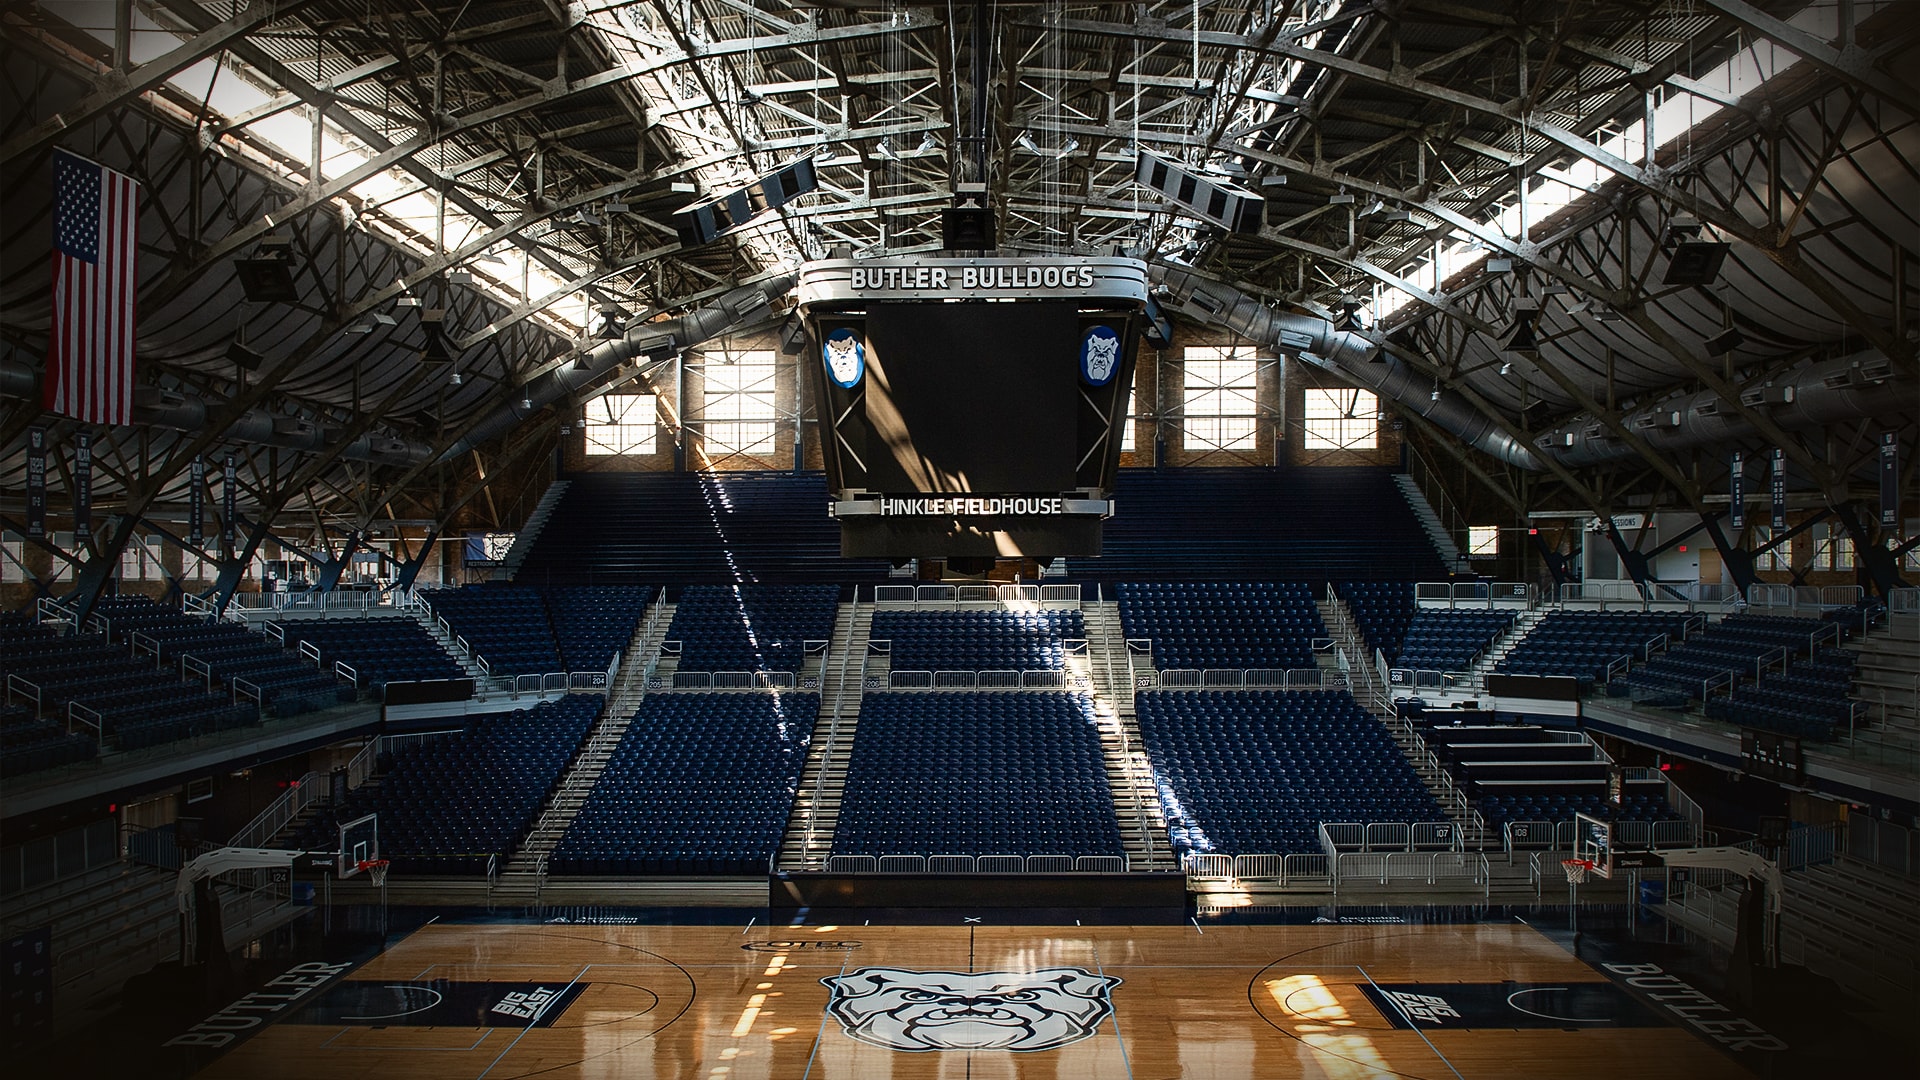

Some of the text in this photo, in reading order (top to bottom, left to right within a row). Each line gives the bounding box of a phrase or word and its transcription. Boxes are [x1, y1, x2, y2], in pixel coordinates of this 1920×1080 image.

[851, 266, 1094, 289] BUTLER BULLDOGS
[880, 498, 1062, 516] HINKLE FIELDHOUSE
[1614, 518, 1636, 528] ESSIONS
[1513, 588, 1526, 596] 208
[592, 677, 605, 685] 204
[1391, 674, 1403, 682] 208
[1436, 829, 1449, 838] 107
[1514, 829, 1528, 837] 108
[273, 873, 287, 882] 124
[161, 961, 354, 1048] BUTLER
[490, 991, 529, 1015] BIG
[511, 986, 556, 1019] EAST
[1391, 991, 1444, 1025] EAST
[1416, 994, 1462, 1018] BIG
[1600, 962, 1790, 1052] BUTLER
